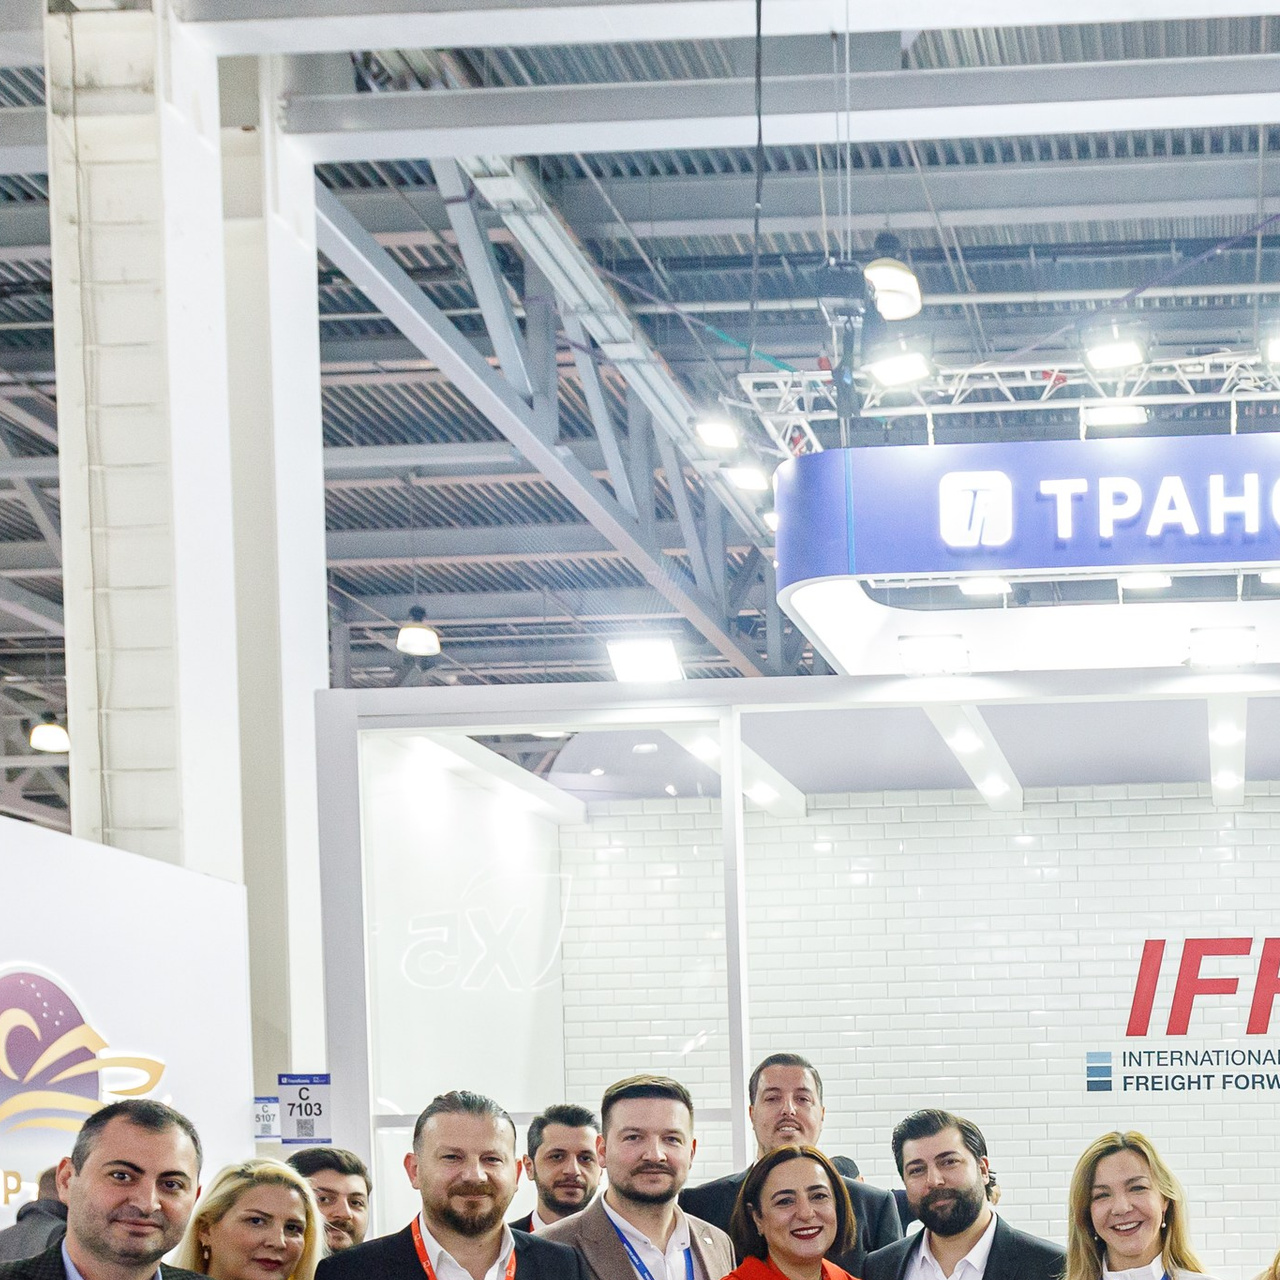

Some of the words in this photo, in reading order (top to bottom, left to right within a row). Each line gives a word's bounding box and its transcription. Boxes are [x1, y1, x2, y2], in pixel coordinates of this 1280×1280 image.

[1122, 1074, 1215, 1092] FREIGHT
[287, 1102, 323, 1117] 7103
[255, 1113, 276, 1123] 5107
